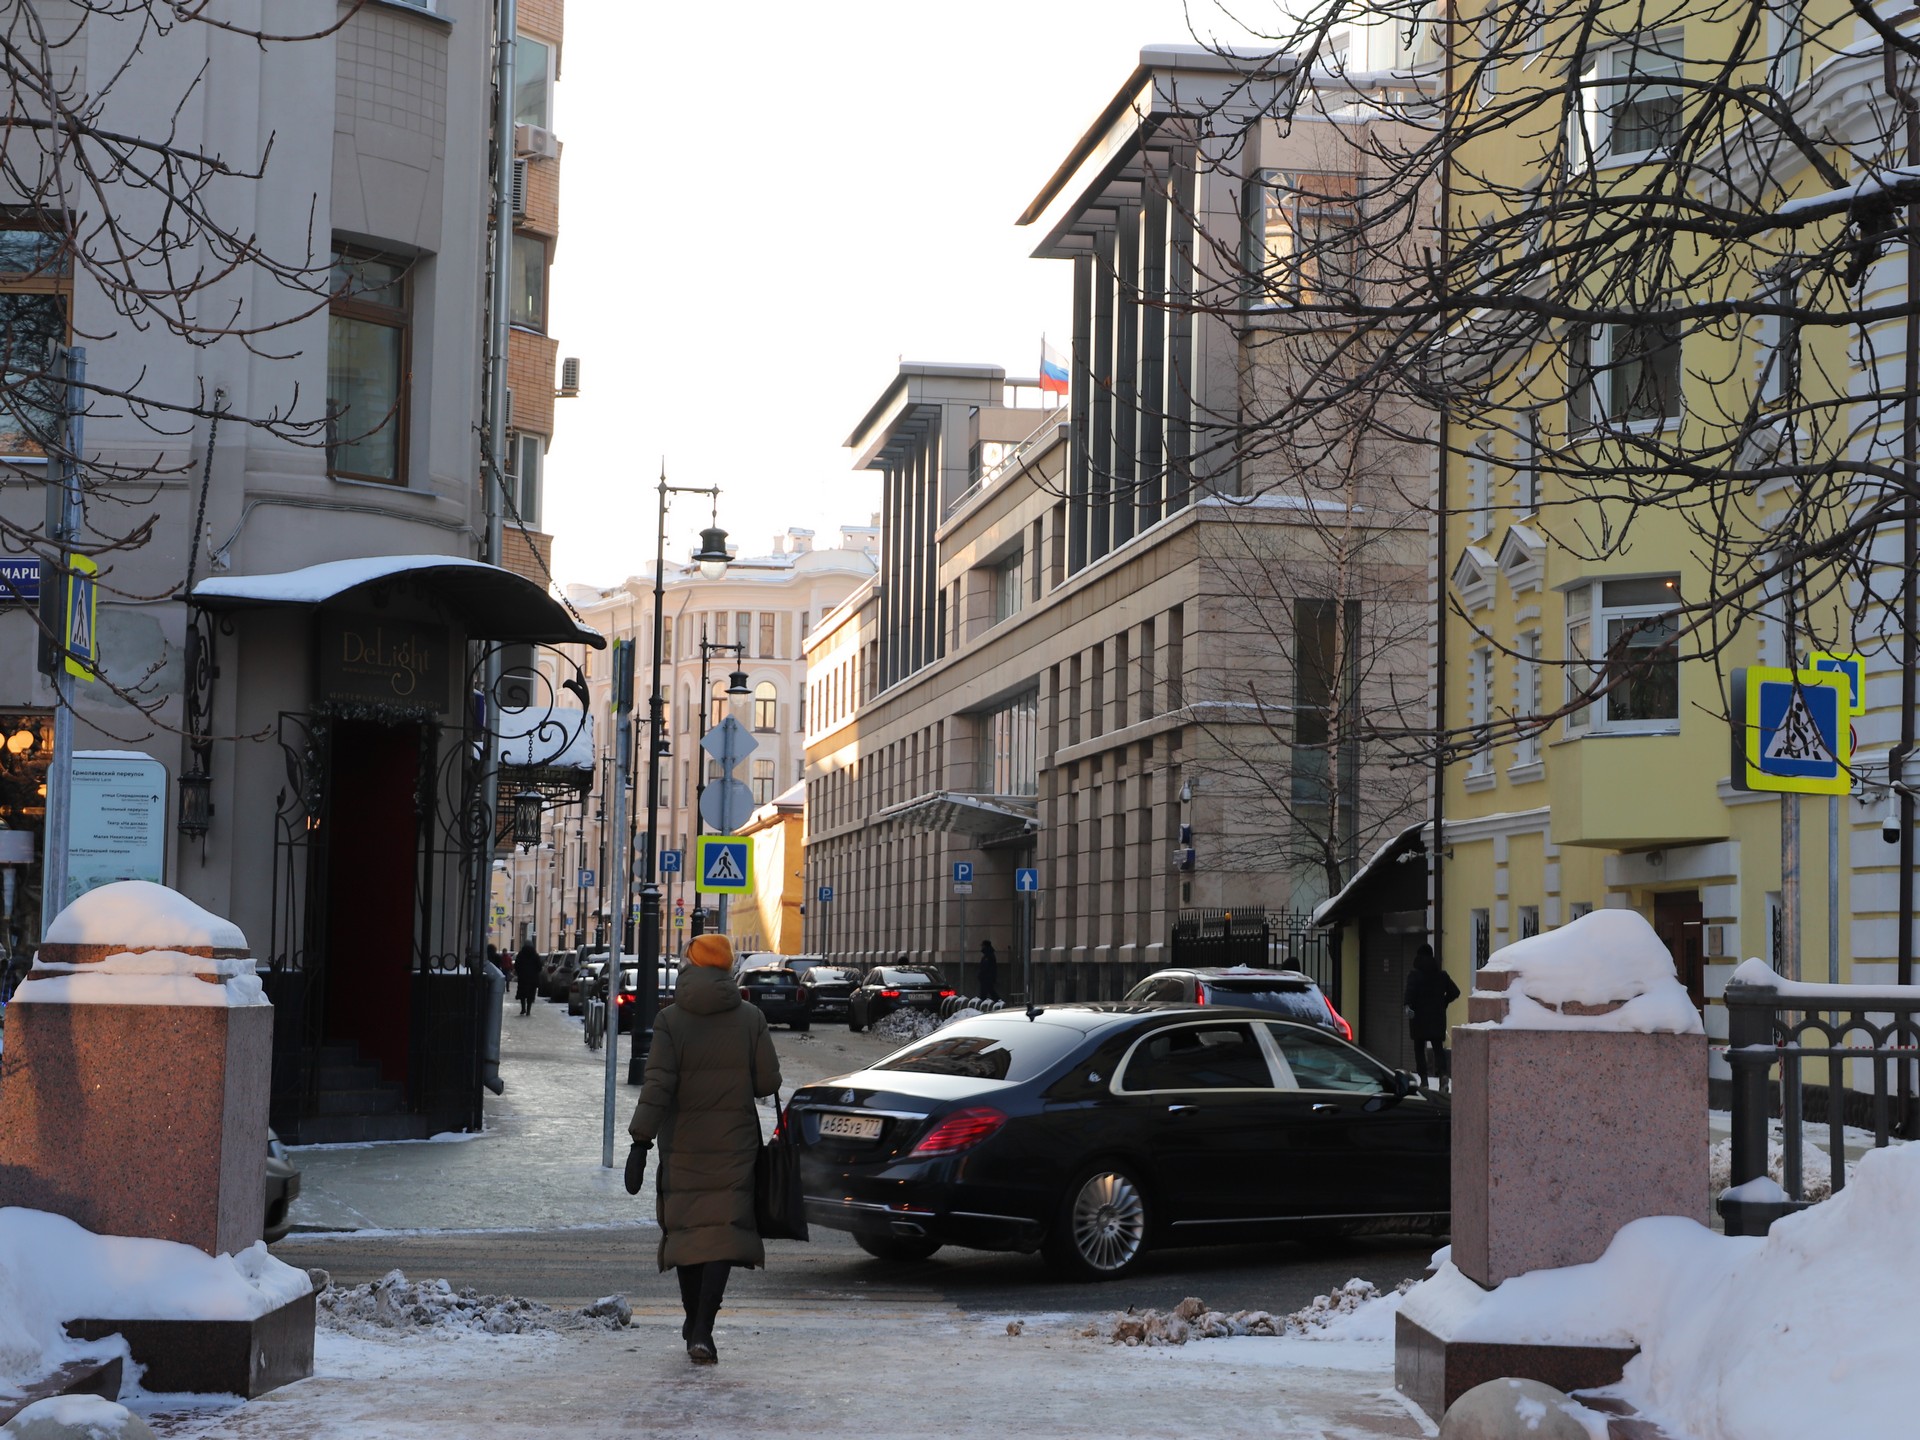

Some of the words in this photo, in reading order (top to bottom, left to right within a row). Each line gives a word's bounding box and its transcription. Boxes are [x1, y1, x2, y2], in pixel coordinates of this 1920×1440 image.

[0, 567, 40, 579] ИАРШ
[343, 626, 431, 696] DeLight
[664, 853, 676, 870] P
[582, 871, 592, 884] P
[959, 864, 969, 880] P
[865, 1119, 880, 1132] 777
